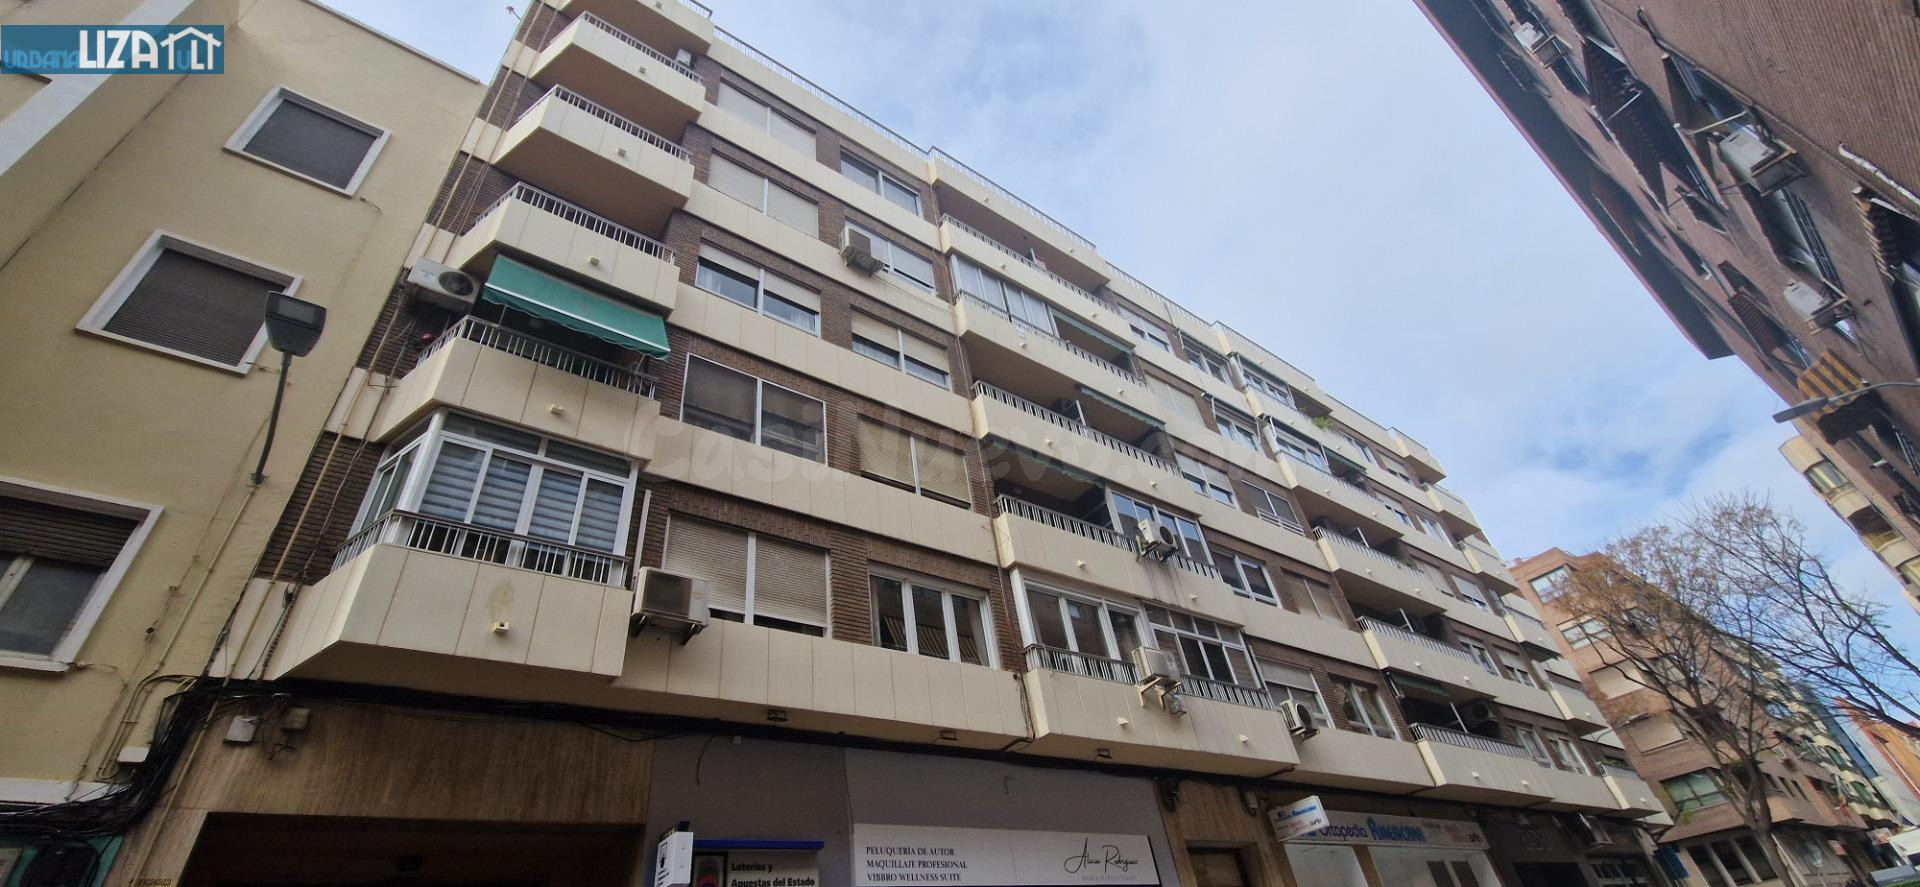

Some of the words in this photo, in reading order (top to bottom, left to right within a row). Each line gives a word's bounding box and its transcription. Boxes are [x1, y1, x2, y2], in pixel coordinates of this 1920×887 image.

[866, 846, 915, 856] PELUQUERÍA
[917, 848, 928, 856] DE
[930, 848, 955, 856] AUTOR
[767, 864, 774, 872] y
[866, 860, 916, 869] MAQUILLAJE
[918, 861, 968, 869] PROFESIONAL
[731, 879, 772, 887] Apuestas
[773, 878, 785, 887] del
[787, 877, 815, 887] Estado
[867, 873, 897, 881] VIBBRO
[899, 873, 939, 882] WELLNESS
[940, 873, 962, 881] SUITE
